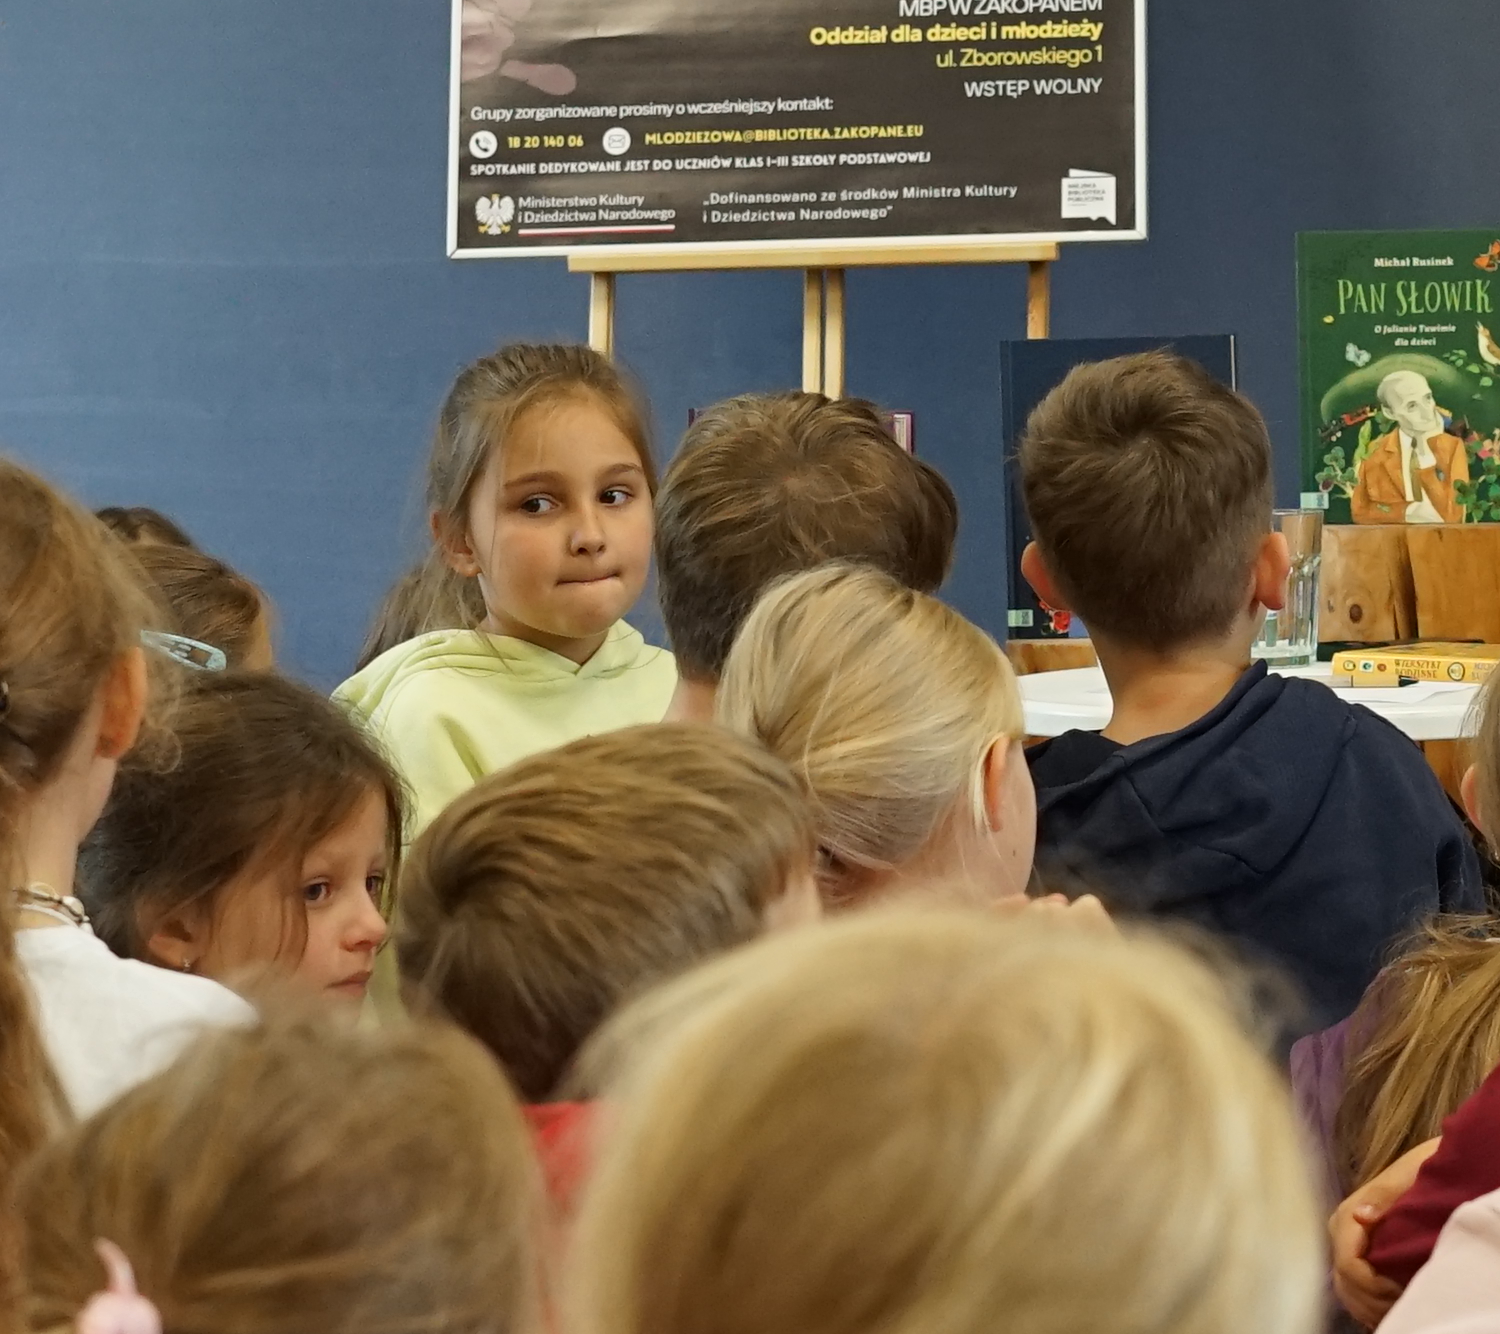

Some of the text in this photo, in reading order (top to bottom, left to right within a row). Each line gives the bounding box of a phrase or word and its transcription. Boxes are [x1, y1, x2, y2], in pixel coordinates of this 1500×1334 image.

[809, 19, 1103, 45] Oddział dla dzieci i młodzieży
[936, 45, 1103, 68] ul. Zborowskiego 1
[964, 78, 1102, 99] WSTĘP WOLNY
[470, 96, 834, 122] Grupy zorganizowane prosimy o wcześniejszy kontakt:
[524, 136, 540, 148] 20
[543, 135, 564, 148] 140
[568, 135, 584, 147] 06
[470, 163, 536, 176] SPOTKANIE
[539, 160, 622, 174] DEDYKOWANE
[623, 159, 649, 172] JEST
[652, 159, 672, 171] DO
[675, 156, 732, 170] UCZNIÓW
[735, 155, 764, 168] KLAS
[791, 154, 837, 166] SZKOŁY
[839, 151, 931, 165] PODSTAWOWEJ
[518, 194, 645, 208] Ministerstwo Kultury
[820, 191, 837, 202] ze
[840, 188, 899, 201] środków
[903, 186, 961, 199] Ministra
[964, 184, 1017, 199] Kultury
[524, 210, 597, 223] Dziedzictwa
[599, 208, 676, 221] Narodowego
[711, 208, 796, 223] Dziedzictwa
[1374, 256, 1454, 267] Michał Rusinek
[1337, 279, 1493, 316] PAN SŁOWIK
[1394, 337, 1436, 347] dla dzieci
